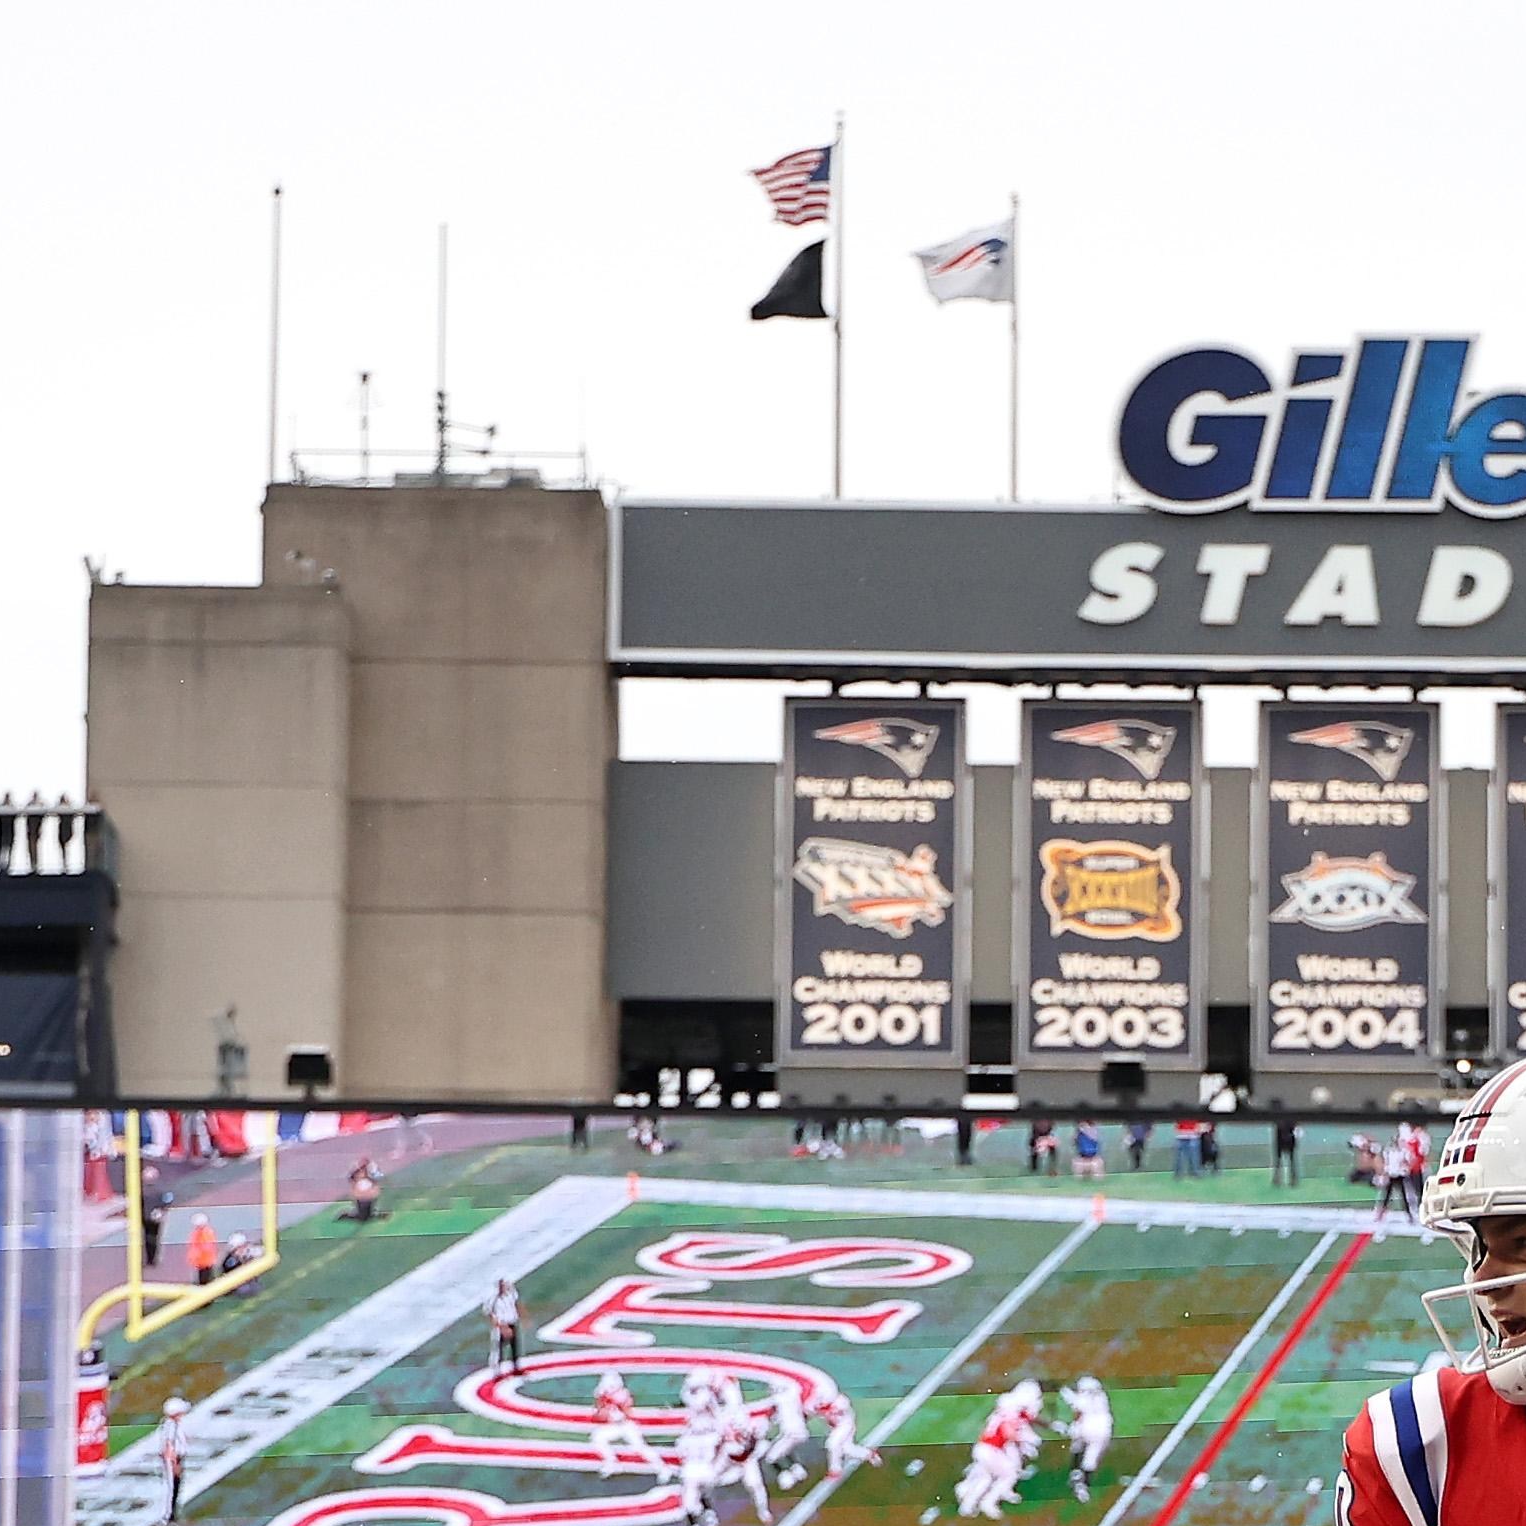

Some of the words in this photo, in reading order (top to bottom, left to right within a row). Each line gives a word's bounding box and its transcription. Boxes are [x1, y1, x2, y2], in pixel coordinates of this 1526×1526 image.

[813, 801, 935, 824] PATRIOTS
[1050, 801, 1173, 825] PATRIOTS
[1288, 801, 1410, 826] PATRIOTS
[820, 951, 923, 978] WORLD
[1059, 952, 1161, 980] WORLD
[1297, 954, 1399, 982] WORLD
[792, 977, 950, 1004] CHAMPIONS
[1031, 978, 1189, 1006] CHAMPIONS
[1269, 980, 1427, 1007] CHAMPIONS
[802, 1003, 941, 1045] 2001
[1033, 1005, 1186, 1048] 2003
[1271, 1007, 1425, 1049] 2004
